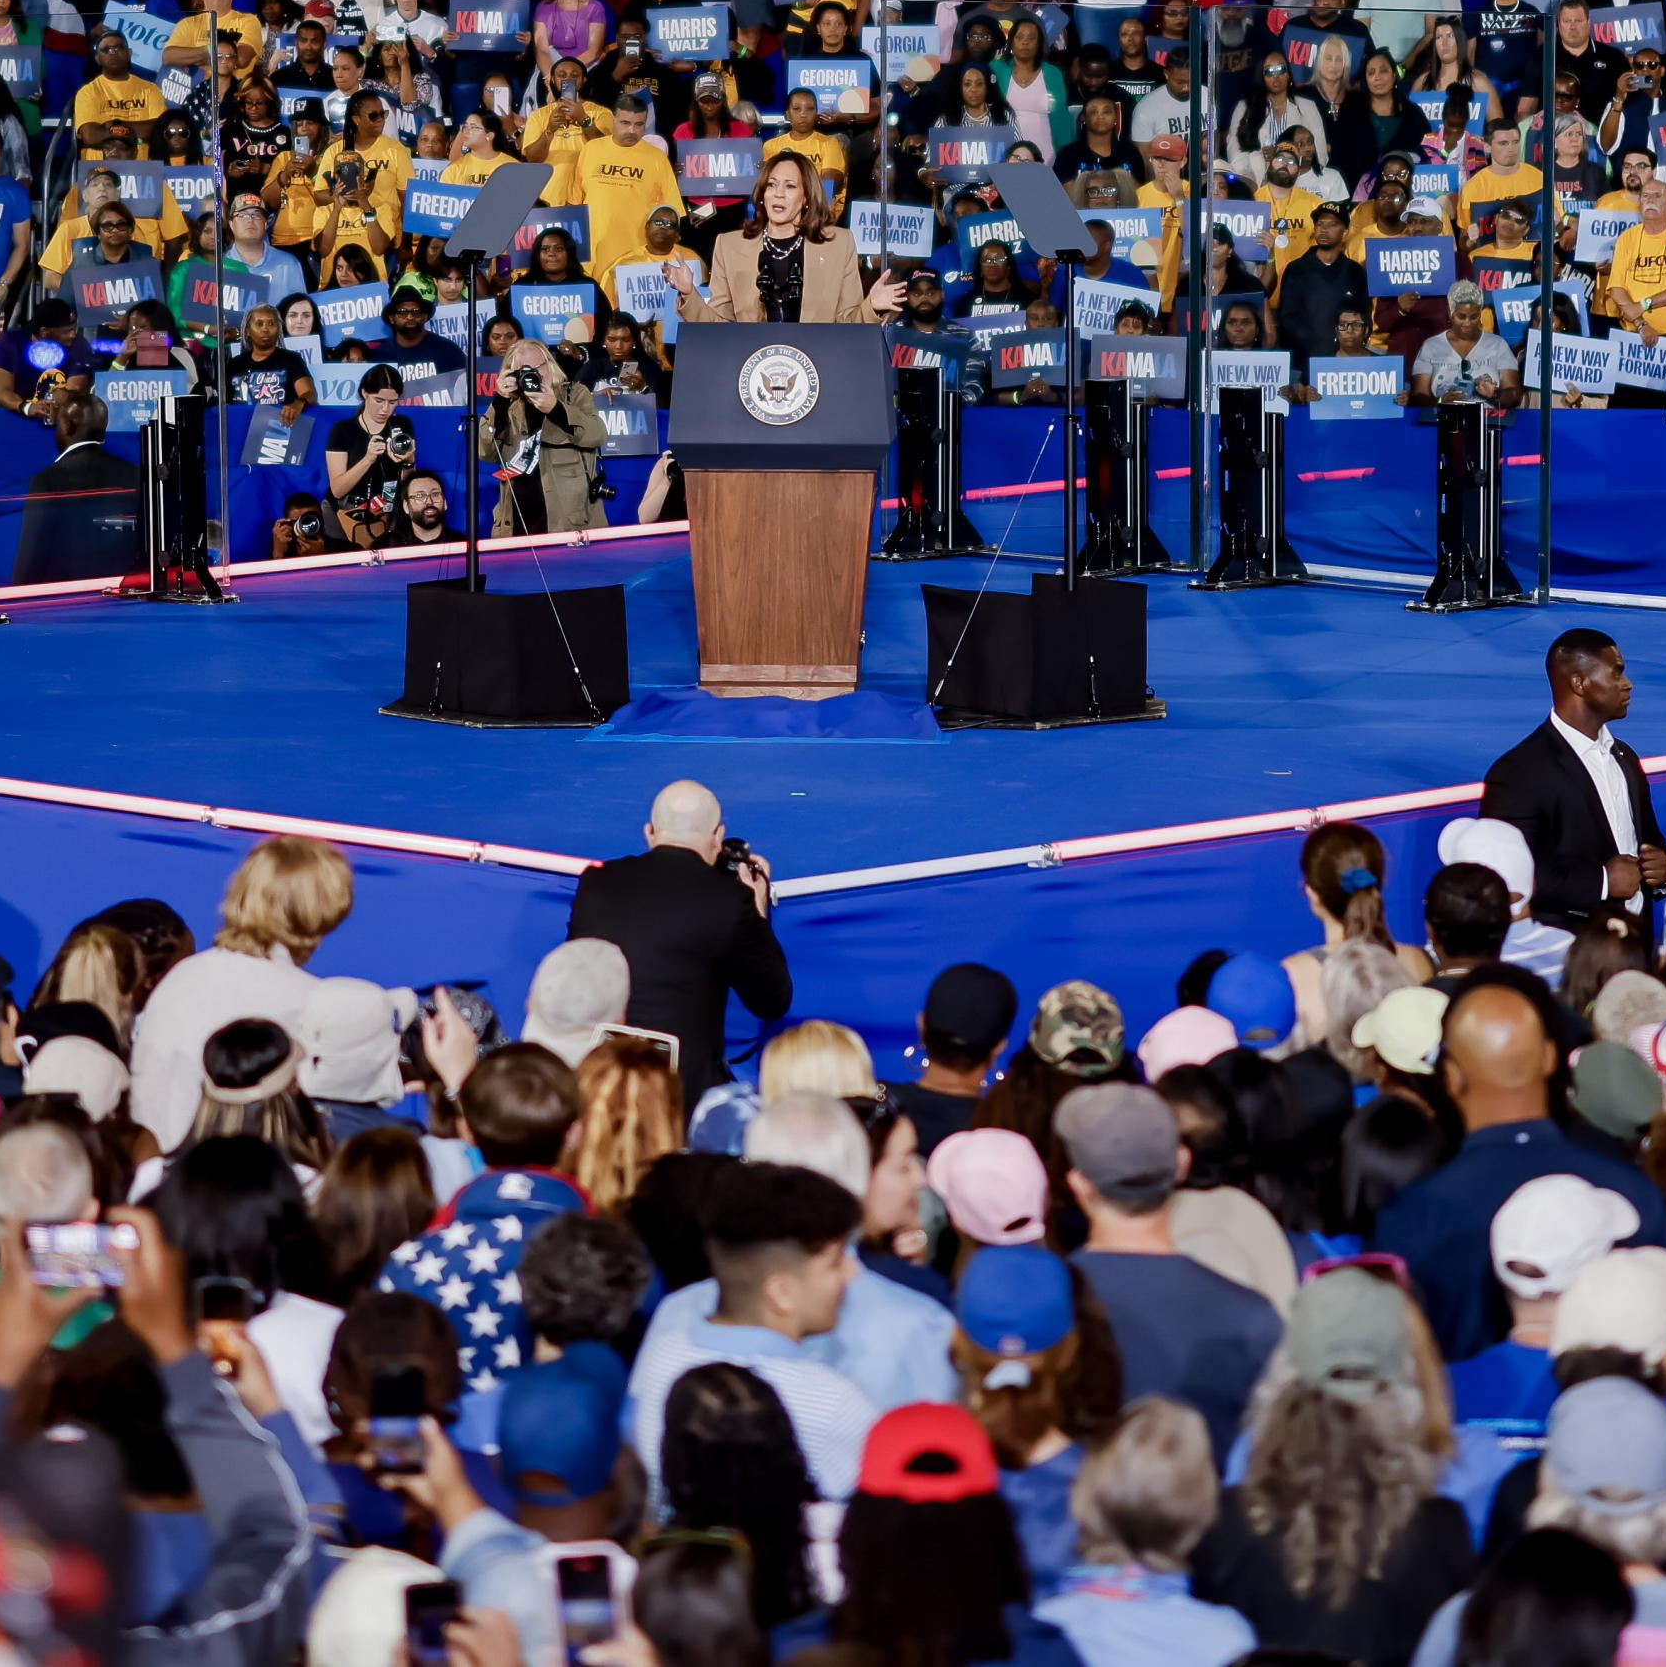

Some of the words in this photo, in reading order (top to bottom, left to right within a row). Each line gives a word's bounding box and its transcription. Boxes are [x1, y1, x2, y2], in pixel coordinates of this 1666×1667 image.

[456, 11, 520, 33] KAMALA
[658, 17, 717, 39] HARRIS
[1593, 17, 1659, 44] KAMALA
[116, 18, 169, 51] vote
[668, 36, 709, 52] WALZ
[874, 36, 926, 53] GORGIA
[800, 68, 858, 86] GEORGIA
[1168, 117, 1209, 134] BLAK
[232, 137, 278, 157] Vote
[939, 141, 1005, 165] KAMALA
[601, 165, 644, 179] UFCW
[685, 152, 756, 178] KAMALA
[1412, 174, 1449, 193] ORGIA
[411, 193, 474, 220] FREEDO
[858, 212, 866, 225] A
[898, 216, 924, 231] WAY
[1380, 251, 1440, 271] HARRIS
[625, 275, 633, 293] A
[1389, 270, 1432, 284] WALZ
[83, 277, 155, 308] KAMALA
[1076, 291, 1085, 306] A
[321, 297, 383, 324] REEDOM
[523, 295, 583, 315] GEORGIA
[779, 348, 793, 356] THE
[1581, 347, 1610, 367] WAY
[1627, 343, 1656, 363] NEW
[795, 353, 817, 386] UNITED
[1101, 352, 1175, 377] KAMALA
[1218, 365, 1249, 382] NEW
[1252, 364, 1282, 381] WAY
[740, 353, 763, 399] PRESIDENT
[1317, 371, 1396, 396] FREEDOM
[107, 380, 173, 401] GEORGIA
[748, 400, 765, 420] VICE
[791, 390, 817, 420] STATES
